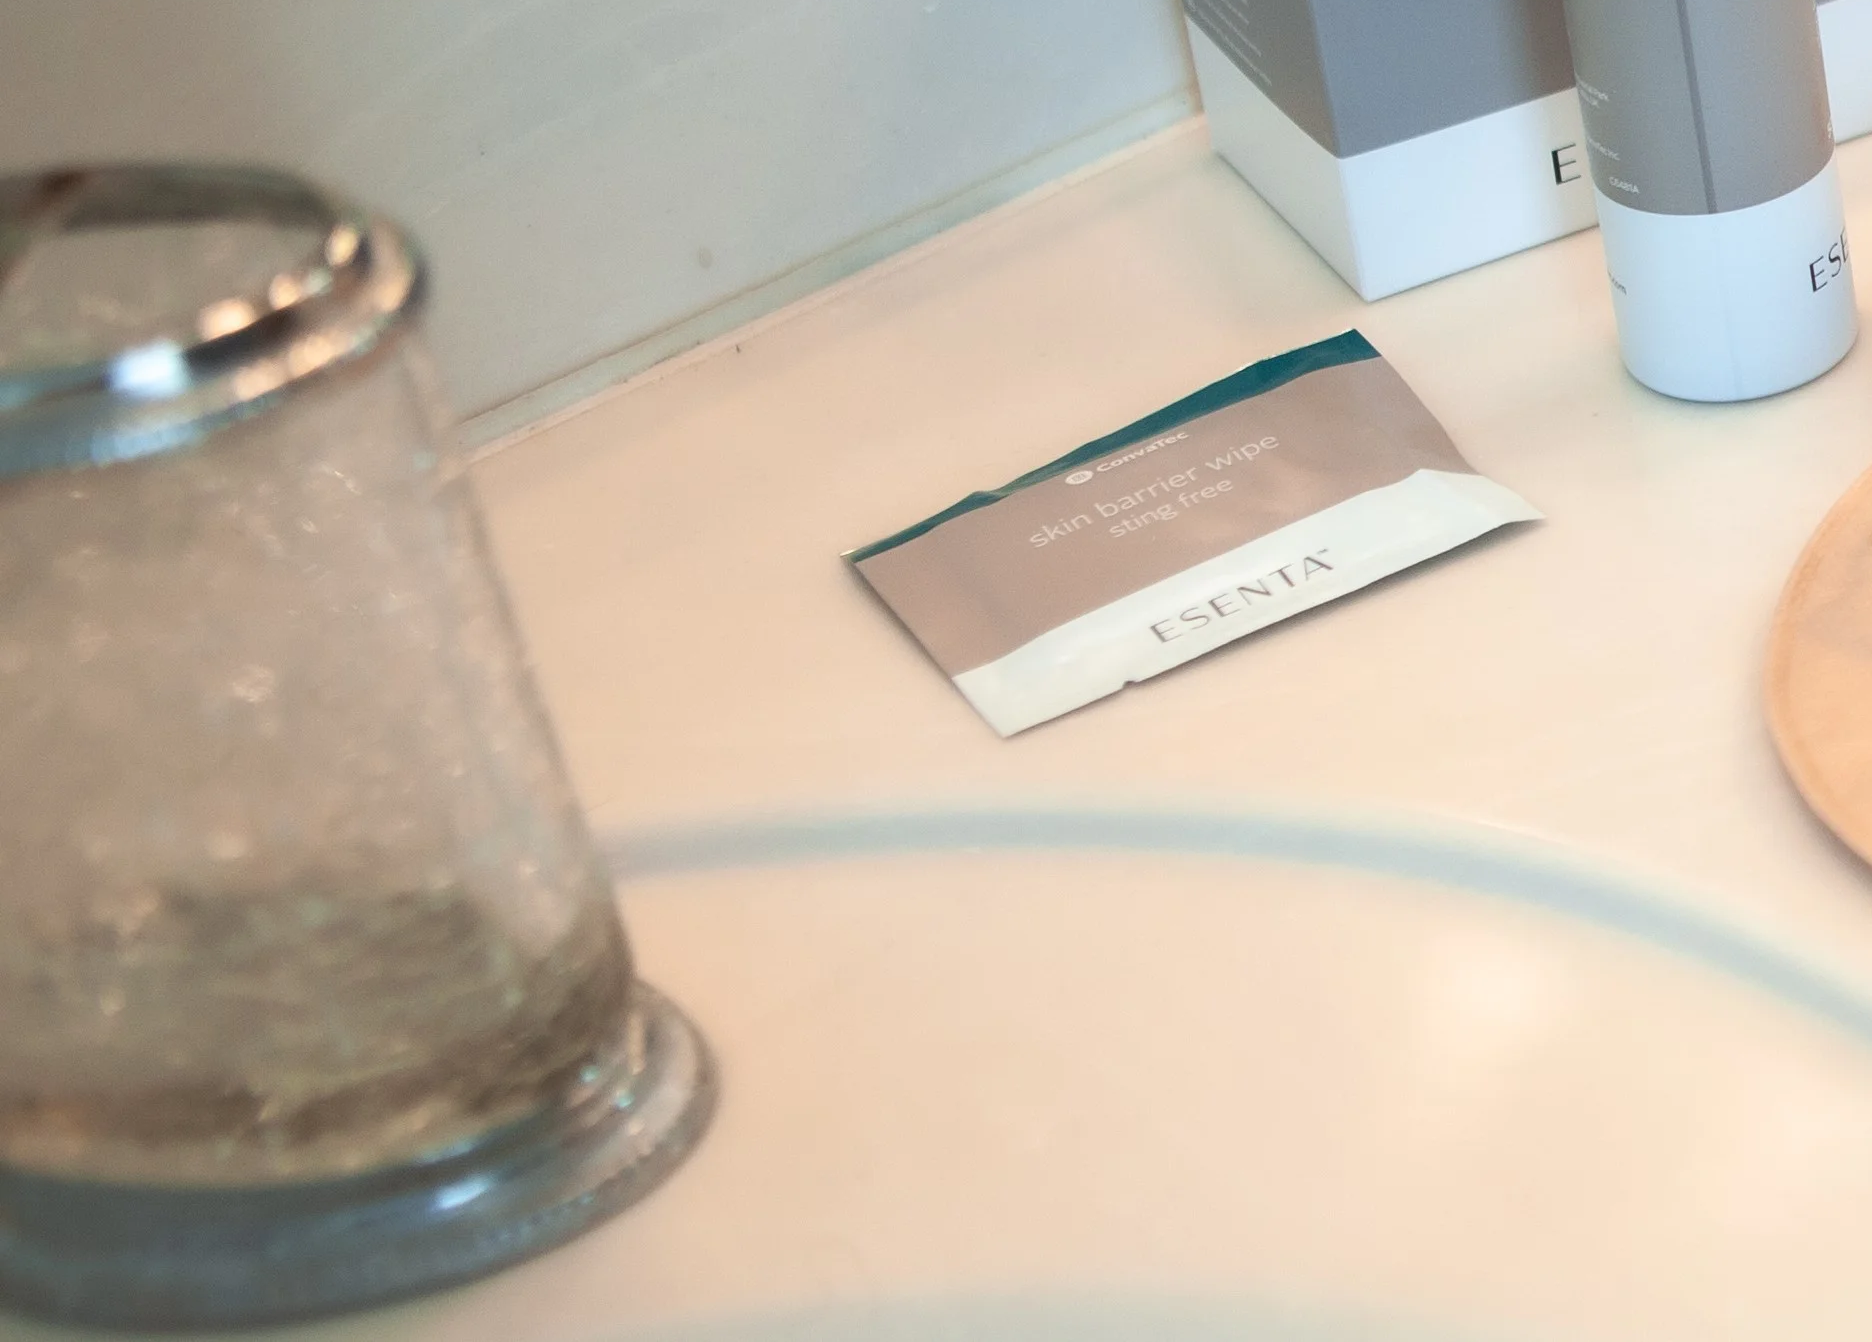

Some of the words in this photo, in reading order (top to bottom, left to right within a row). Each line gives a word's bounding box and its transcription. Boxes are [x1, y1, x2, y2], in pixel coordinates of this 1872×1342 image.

[1809, 225, 1849, 292] ESE
[1096, 431, 1191, 473] ConvaTec
[1029, 512, 1092, 548] skin
[1094, 466, 1200, 518] barrier
[1205, 434, 1280, 471] wipe
[1108, 505, 1179, 538] sting
[1178, 478, 1234, 508] free
